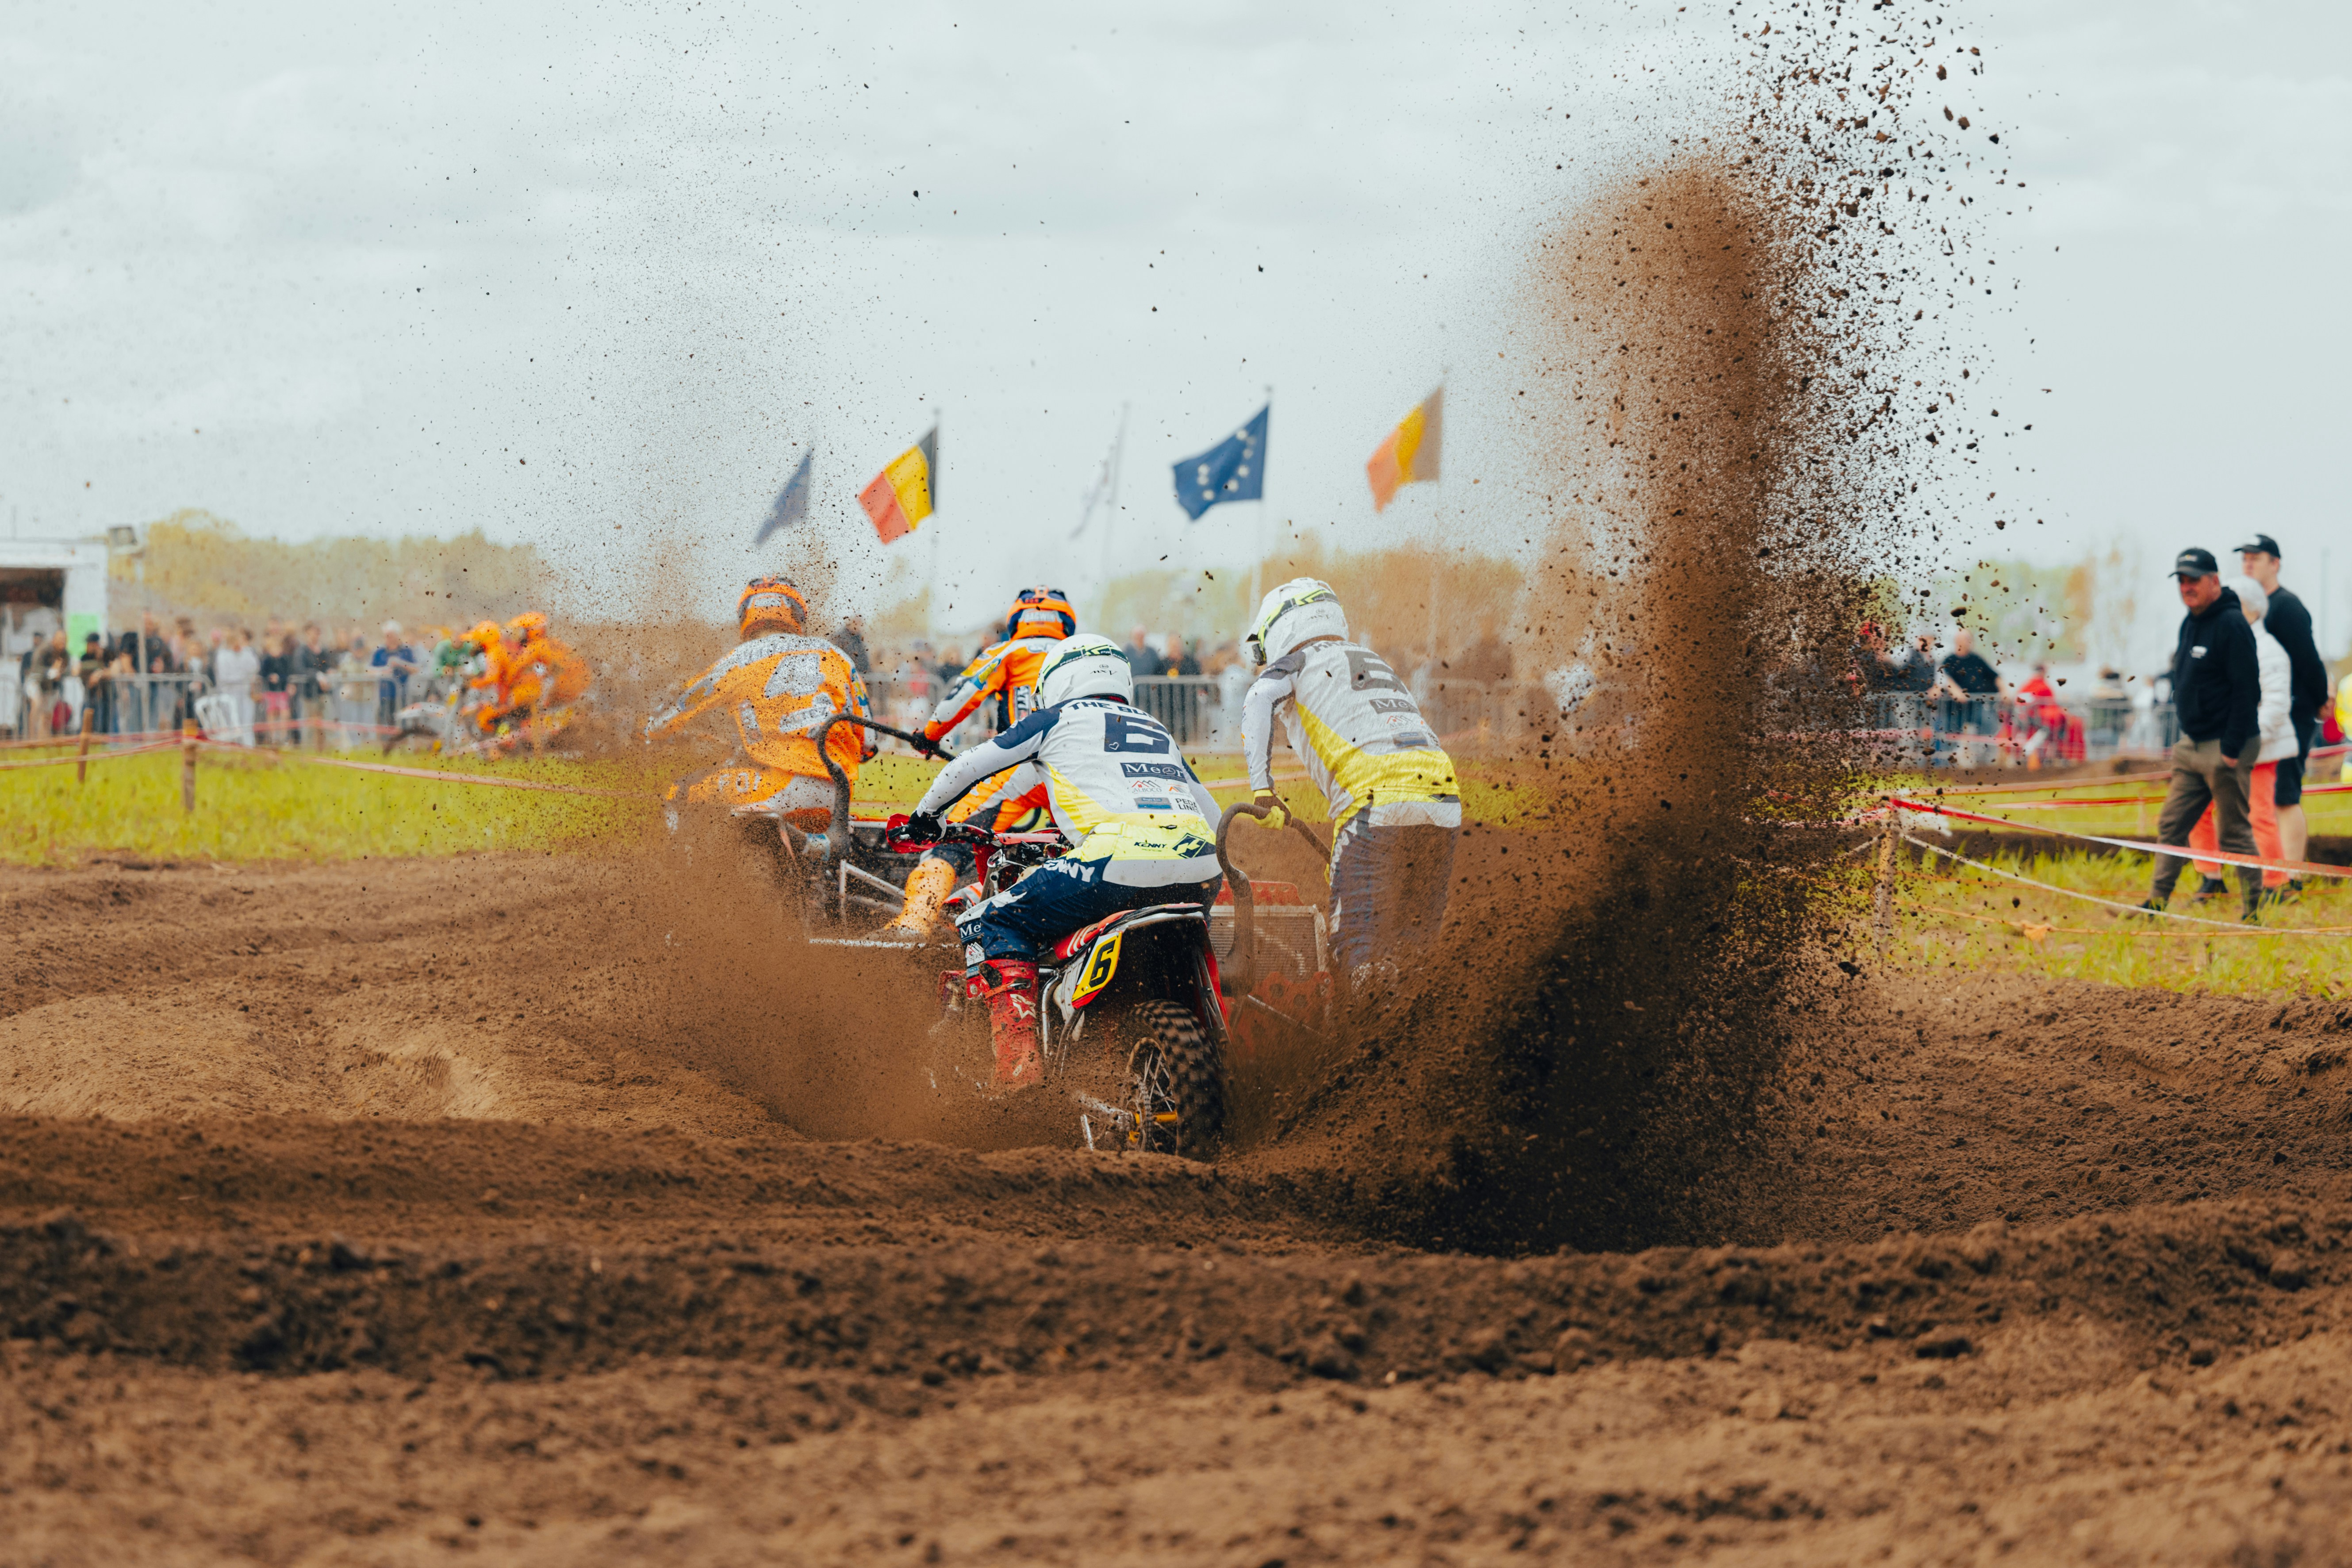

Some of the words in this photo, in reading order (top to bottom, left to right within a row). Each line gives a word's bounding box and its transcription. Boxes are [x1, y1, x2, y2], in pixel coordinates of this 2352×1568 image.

[1068, 702, 1113, 710] THE
[959, 922, 982, 938] Me
[1089, 939, 1116, 988] 6
